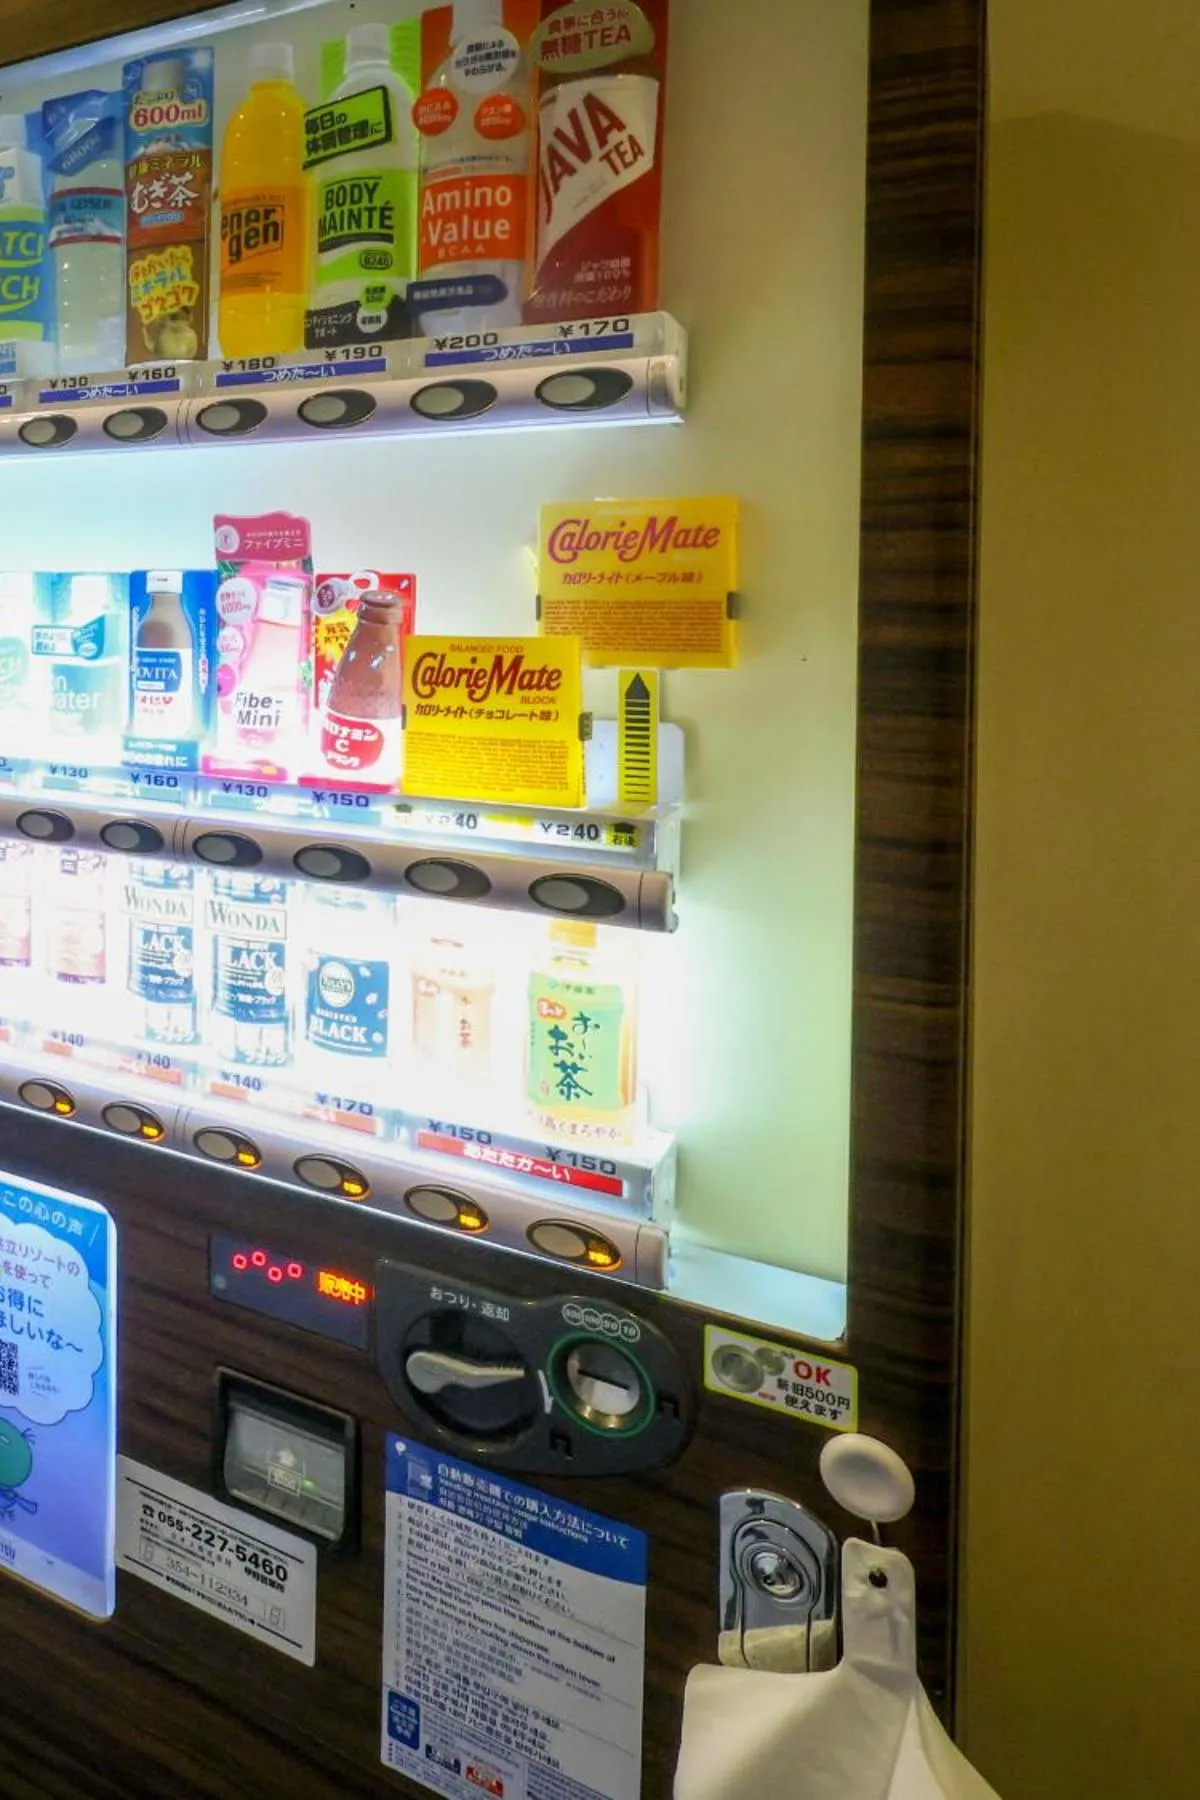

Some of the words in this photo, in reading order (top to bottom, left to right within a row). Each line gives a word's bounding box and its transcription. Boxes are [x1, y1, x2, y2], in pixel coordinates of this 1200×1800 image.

[133, 103, 205, 128] 600ml
[542, 92, 627, 223] JAVA
[600, 137, 645, 176] TEA
[131, 172, 199, 214] むぎ茶
[325, 182, 379, 211] BODY
[422, 182, 512, 215] Amino
[228, 222, 280, 265] gen
[426, 214, 511, 248] Value
[433, 332, 499, 351] ¥200
[558, 318, 630, 338] ¥170
[221, 355, 276, 371] ¥180
[324, 344, 383, 361] ¥190
[128, 367, 177, 382] ¥160
[547, 516, 721, 564] CalorieMate
[411, 651, 562, 702] CalorieMate
[236, 709, 281, 727] Mini
[335, 738, 350, 753] C
[50, 765, 88, 778] ¥130
[130, 773, 179, 789] ¥160
[222, 782, 268, 798] ¥130
[313, 791, 370, 808] ¥150
[123, 885, 188, 918] WONDA
[209, 900, 280, 934] WONDA
[309, 1014, 368, 1043] BLACK
[548, 1024, 593, 1101] お茶
[314, 1091, 374, 1116] ¥170
[428, 1118, 493, 1145] ¥150
[545, 1147, 617, 1176] ¥150
[792, 1359, 834, 1387] OK
[776, 1377, 851, 1411] 新旧500円
[784, 1394, 842, 1421] 使えます
[158, 1510, 289, 1582] 055-227-5460
